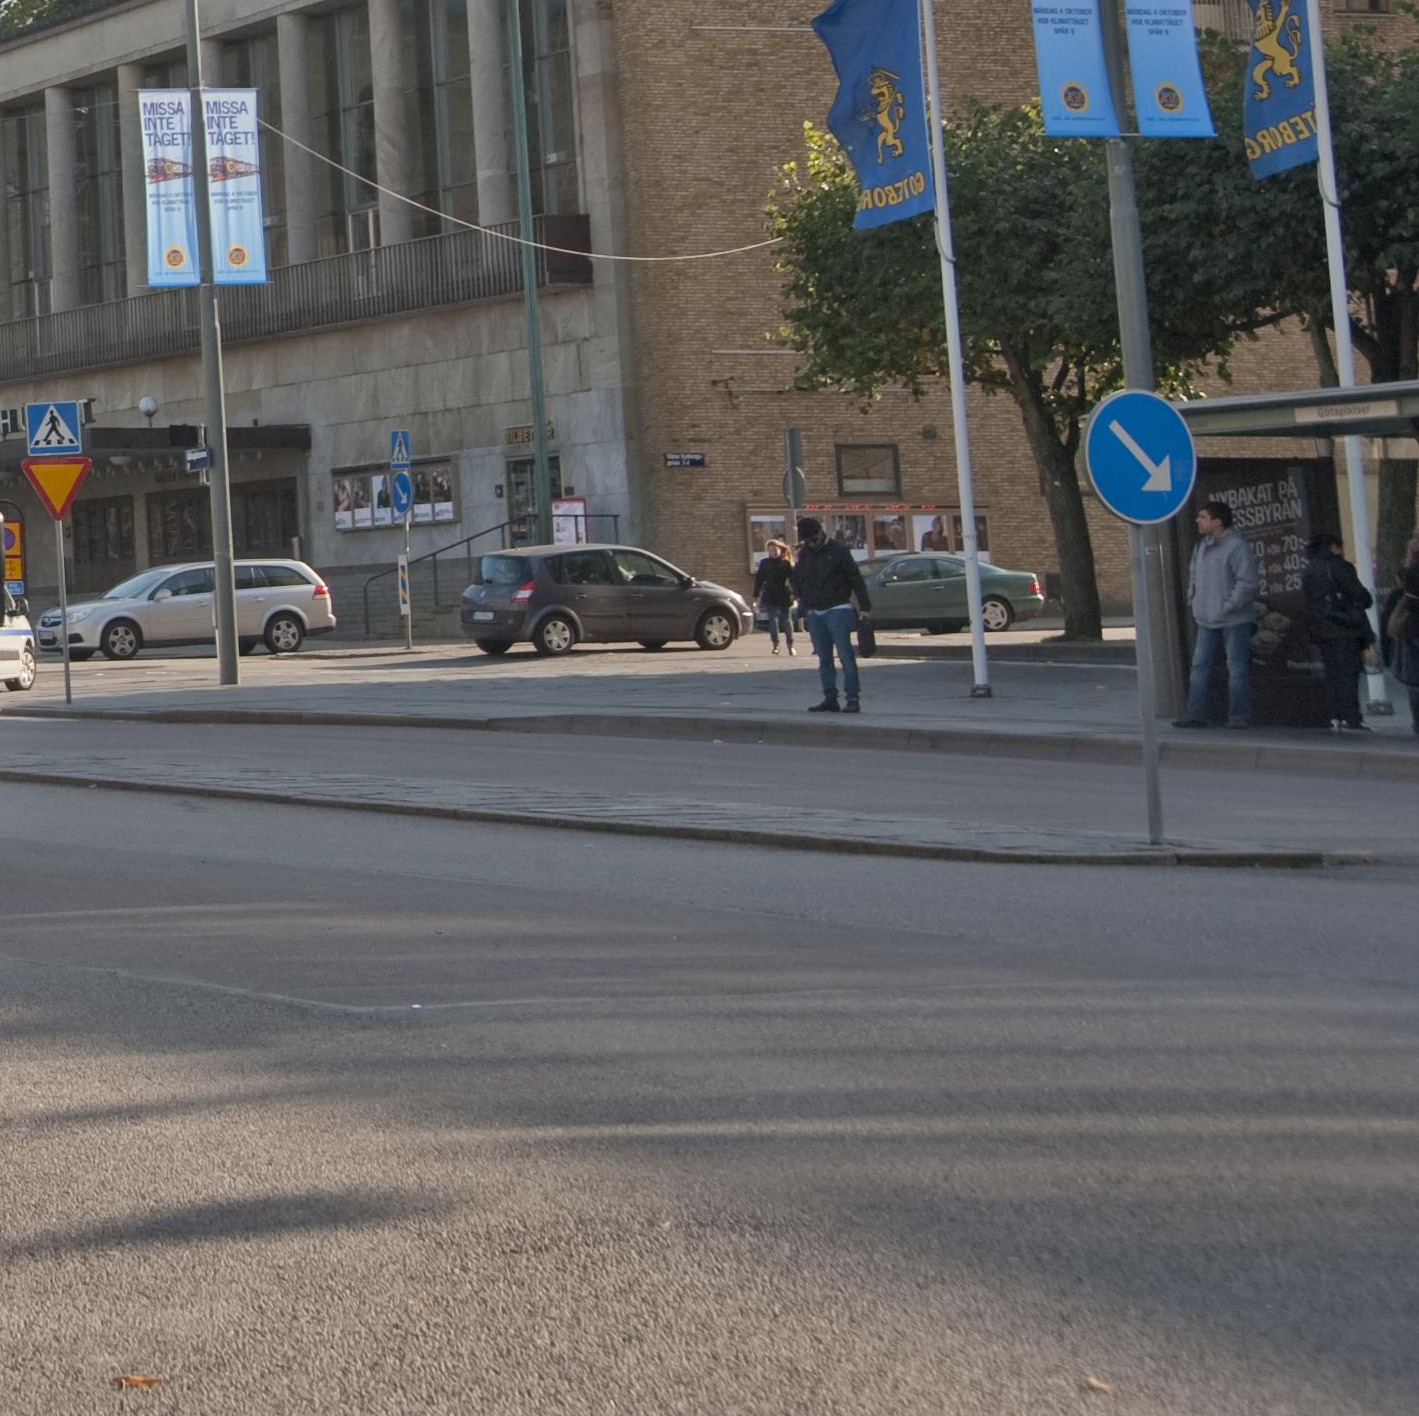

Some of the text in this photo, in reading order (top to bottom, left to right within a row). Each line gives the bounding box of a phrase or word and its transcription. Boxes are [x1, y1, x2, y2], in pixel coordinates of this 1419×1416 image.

[143, 101, 185, 116] MISSA
[205, 100, 249, 115] MISSA
[143, 116, 175, 131] INTE
[206, 115, 239, 130] INTE
[1232, 498, 1303, 529] SSBYRÅN
